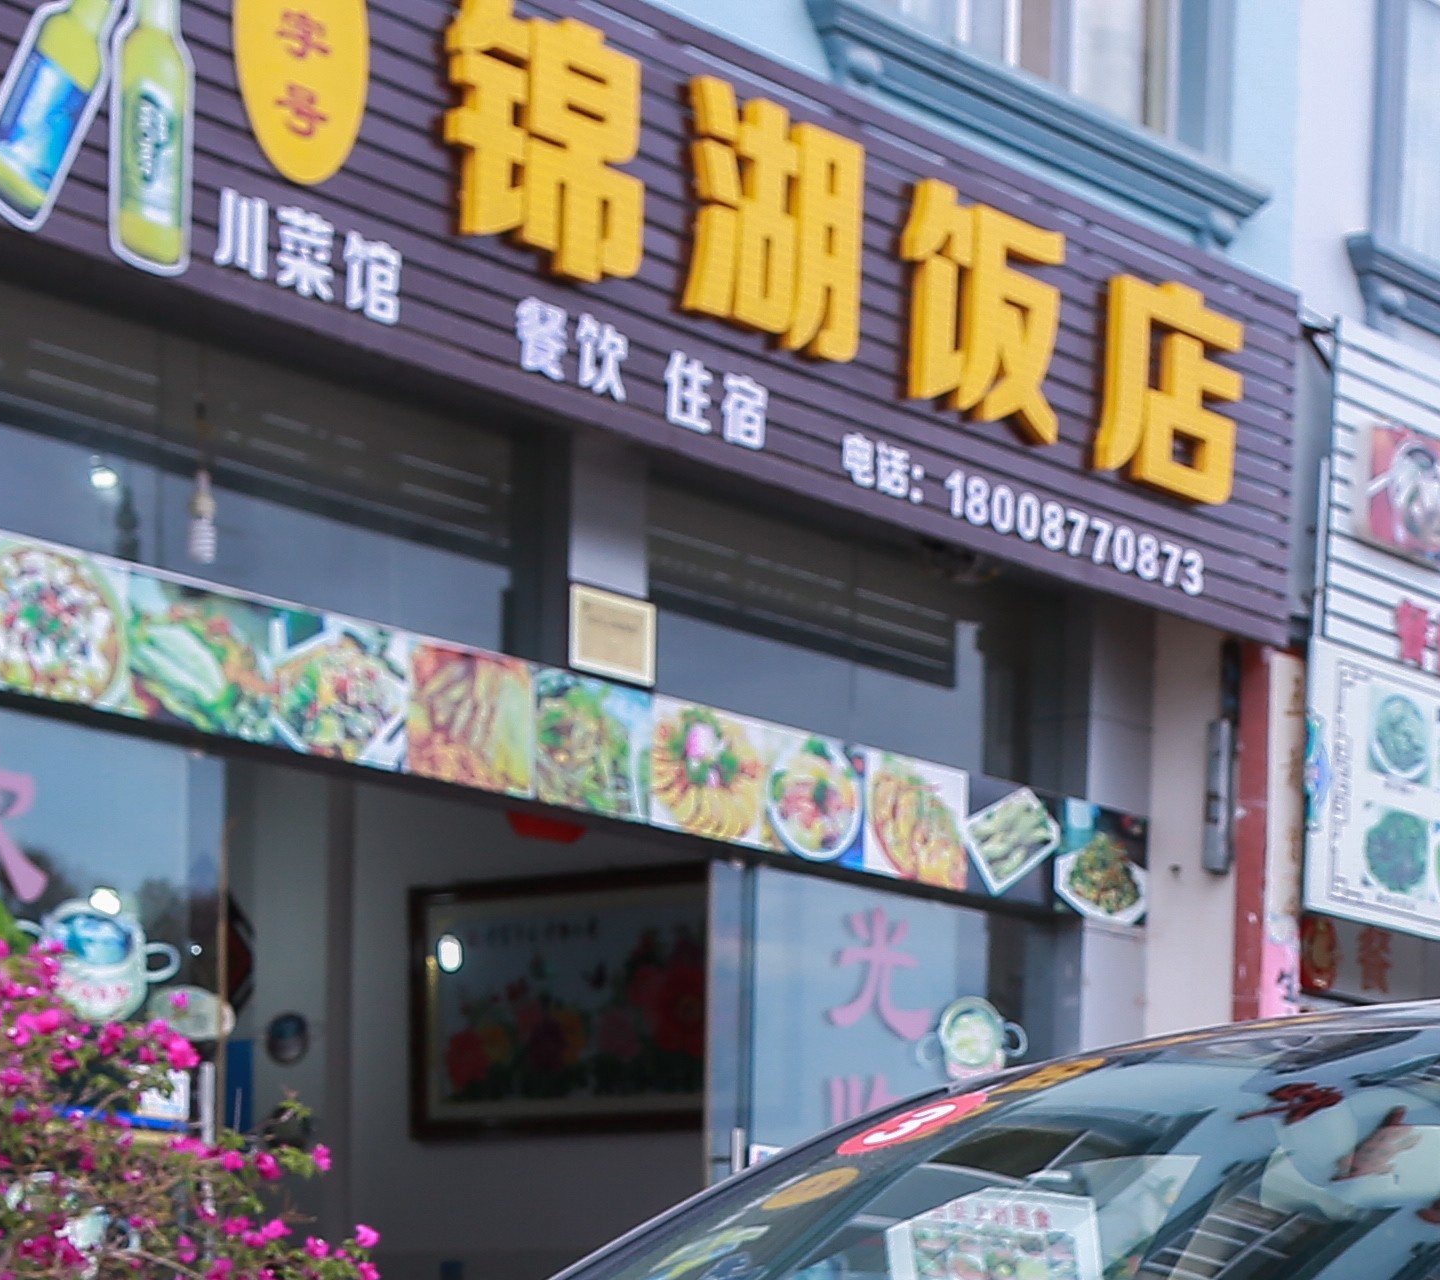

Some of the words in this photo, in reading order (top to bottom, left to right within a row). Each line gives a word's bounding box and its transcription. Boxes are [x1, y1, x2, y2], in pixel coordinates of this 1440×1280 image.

[214, 186, 403, 326] 川菜馆
[444, 0, 1245, 506] 锦湖饭店
[516, 295, 629, 402] 餐饮
[664, 350, 768, 450] 住宿
